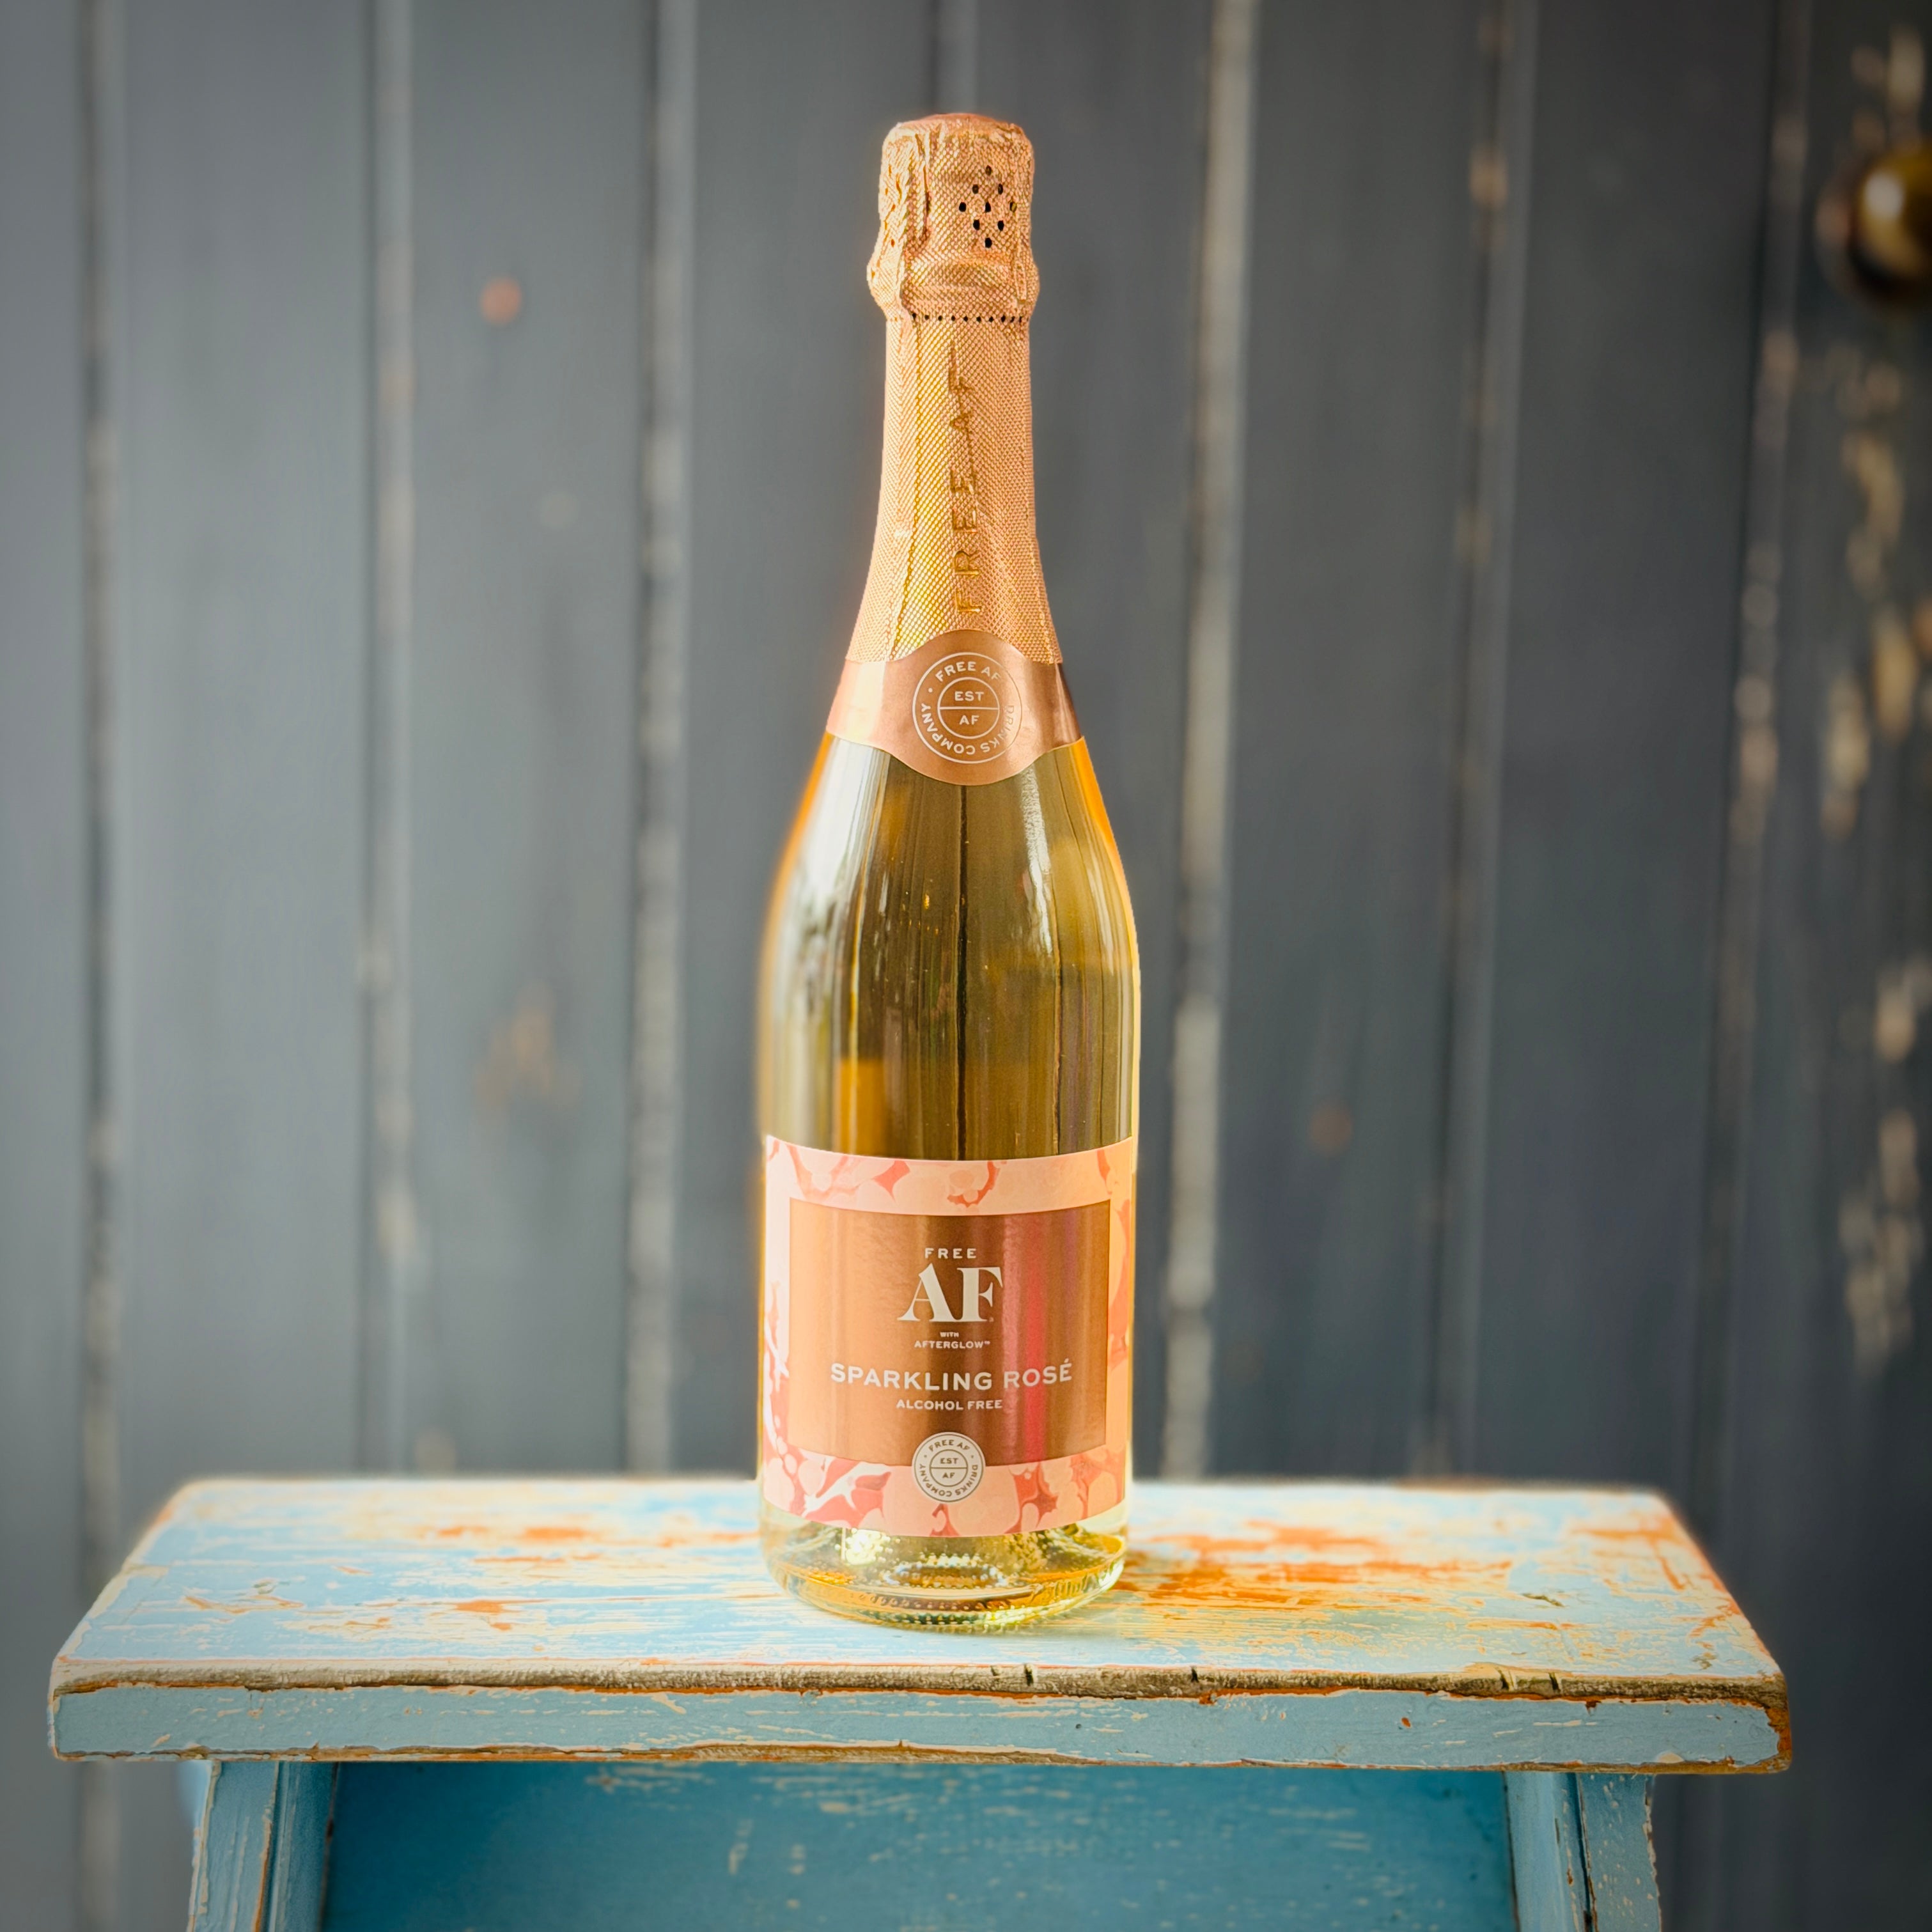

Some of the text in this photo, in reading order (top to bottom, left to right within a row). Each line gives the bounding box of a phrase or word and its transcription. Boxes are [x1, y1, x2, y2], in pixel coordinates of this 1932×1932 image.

[949, 469, 981, 614] FREE
[921, 661, 1015, 756] FREE AF DRINKS COMPANY
[954, 690, 985, 702] EST
[959, 715, 980, 726] AF
[924, 1247, 977, 1259] FREE
[896, 1262, 1004, 1323] AF
[830, 1357, 1073, 1391] SPARKLING ROSÉ
[896, 1398, 1003, 1411] ALCOHOL FREE
[919, 1439, 978, 1497] FREE AF DRINKS COMPANY
